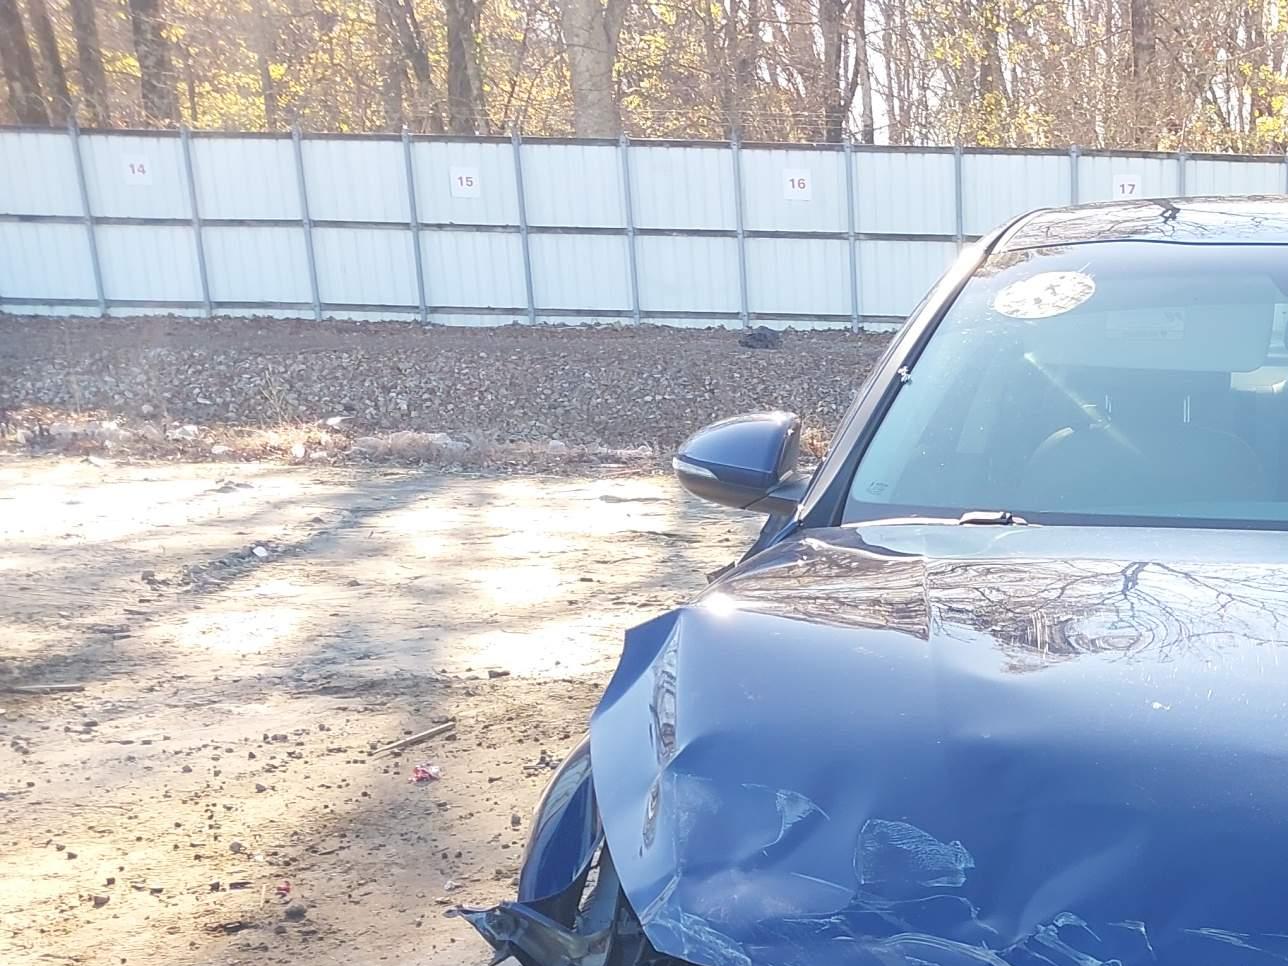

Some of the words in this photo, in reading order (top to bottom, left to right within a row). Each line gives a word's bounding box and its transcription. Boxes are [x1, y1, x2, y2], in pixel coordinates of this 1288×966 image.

[129, 164, 146, 175] 14
[458, 176, 474, 187] 15
[789, 178, 806, 189] 16
[1119, 184, 1136, 194] 17
